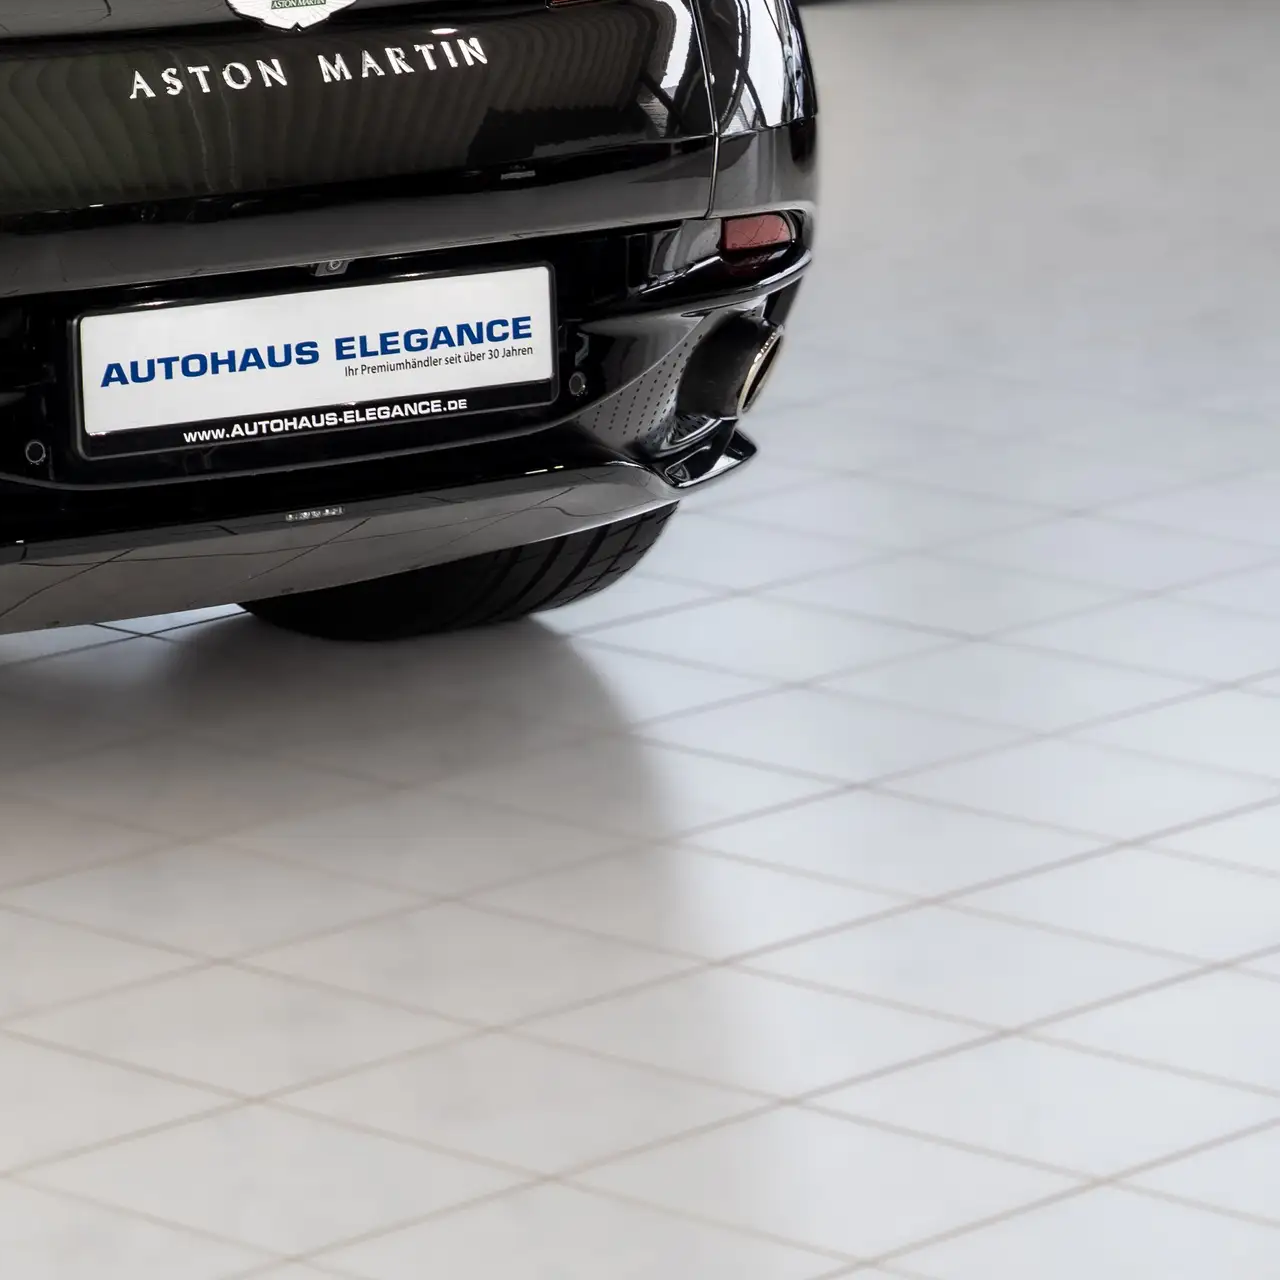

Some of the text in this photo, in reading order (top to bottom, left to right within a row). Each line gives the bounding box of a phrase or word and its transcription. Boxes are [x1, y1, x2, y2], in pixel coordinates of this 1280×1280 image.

[272, 0, 297, 8] ASTON
[130, 38, 487, 99] ASTON MARTIN
[100, 316, 532, 388] AUTOHAUS ELEGANCE
[344, 346, 534, 377] Ihr Premiumhändler seit über 30 Jahren
